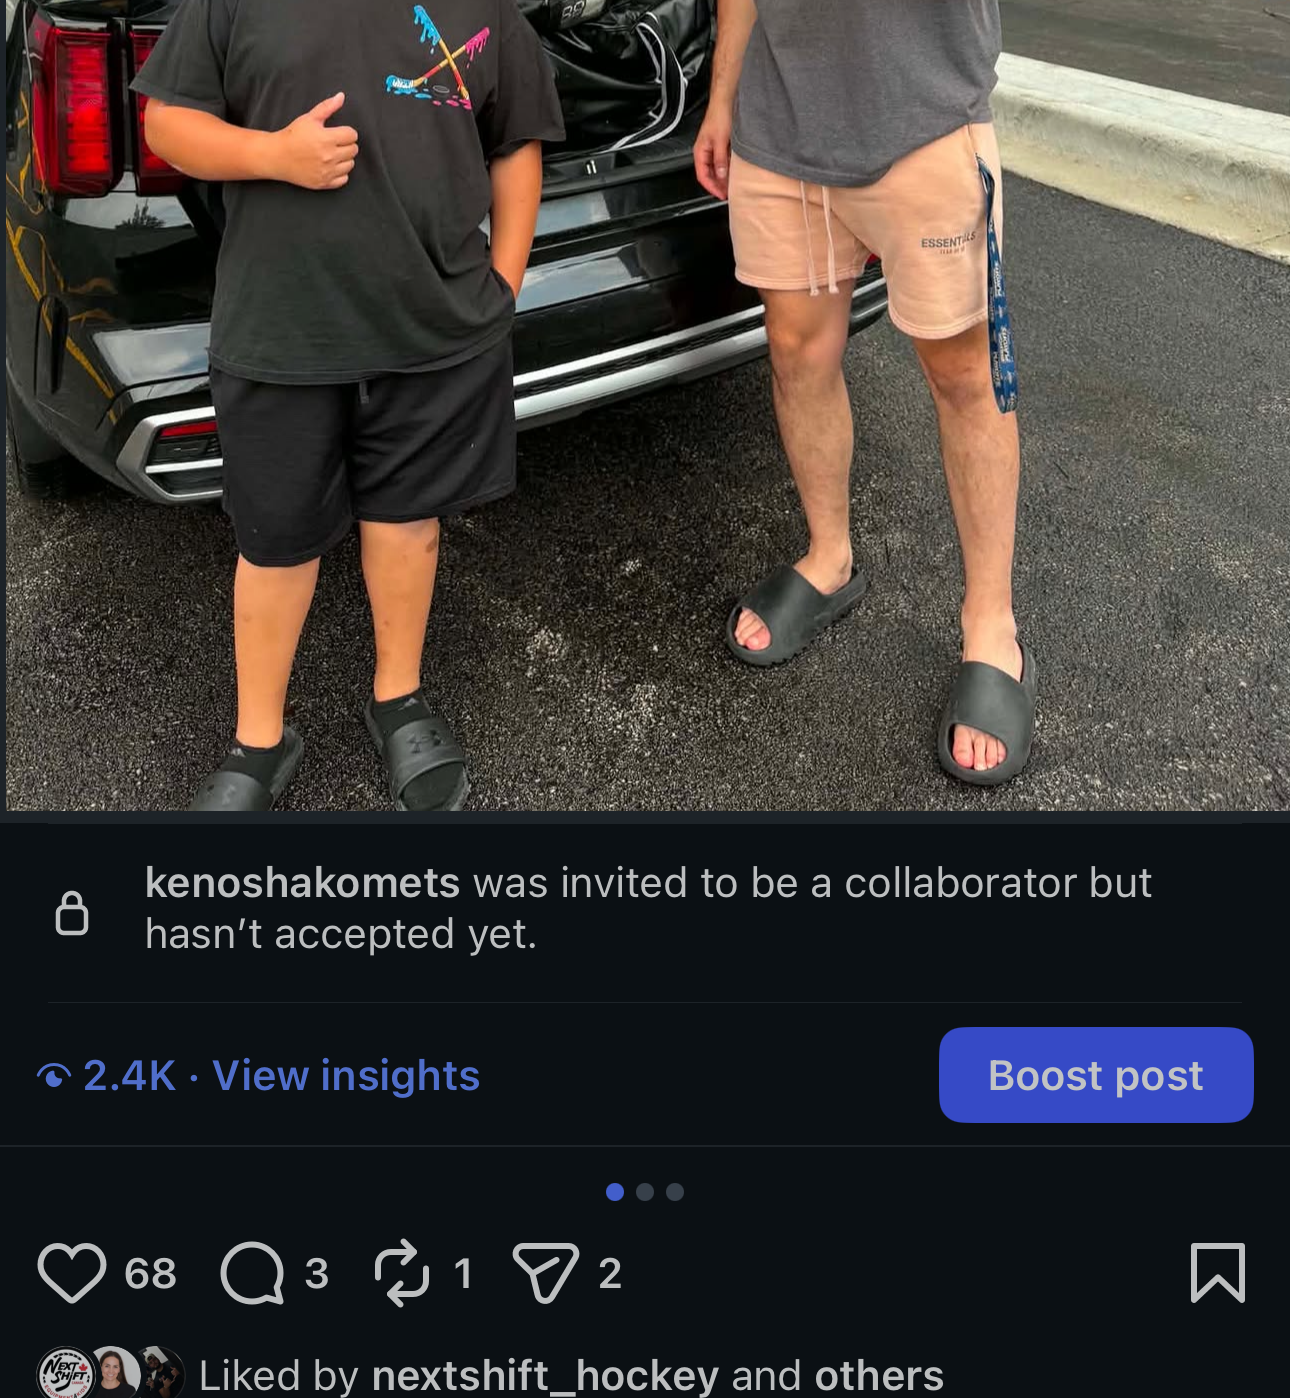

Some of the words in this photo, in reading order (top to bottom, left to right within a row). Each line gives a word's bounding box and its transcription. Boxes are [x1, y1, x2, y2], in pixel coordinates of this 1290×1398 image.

[921, 231, 976, 248] ESSENTLS
[147, 866, 459, 898] kenoshakomets
[473, 874, 547, 898] was
[563, 866, 685, 898] invited
[701, 869, 737, 898] to
[753, 866, 797, 898] be
[812, 874, 830, 898] a
[846, 866, 1077, 898] collaborator
[1091, 866, 1151, 898] but
[276, 917, 452, 956] accepted
[468, 920, 535, 956] yet.
[85, 1060, 176, 1090] 2.4K
[213, 1058, 309, 1091] View
[323, 1058, 479, 1098] insights
[991, 1060, 1102, 1090] Boost
[1117, 1062, 1203, 1098] post
[125, 1258, 176, 1289] 68
[306, 1258, 328, 1289] 3
[455, 1258, 469, 1288] 1
[600, 1258, 621, 1288] 2
[43, 1357, 80, 1375] NEXT
[51, 1371, 87, 1386] SHIFT
[202, 1359, 298, 1391] Liked
[315, 1359, 358, 1398] by
[374, 1358, 719, 1398] nextshift_hockey
[733, 1359, 799, 1391] and
[816, 1359, 943, 1391] others
